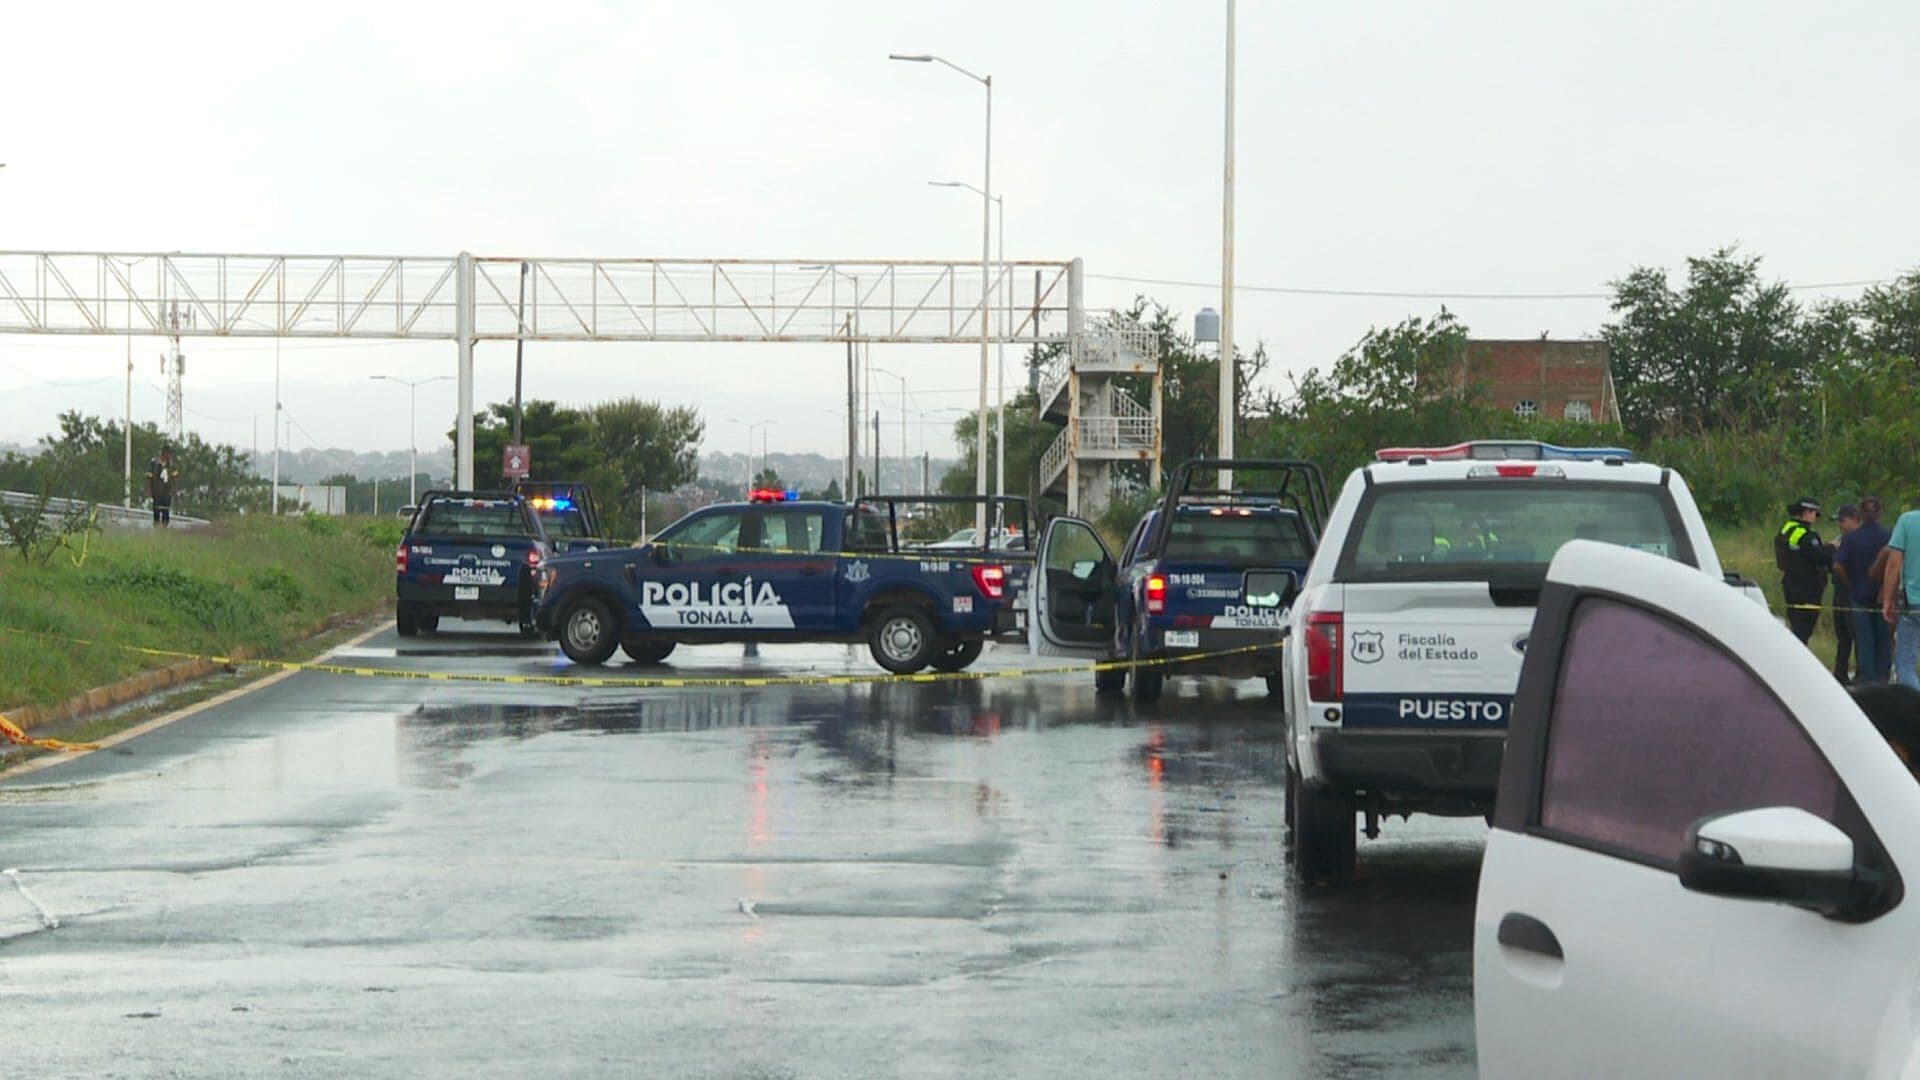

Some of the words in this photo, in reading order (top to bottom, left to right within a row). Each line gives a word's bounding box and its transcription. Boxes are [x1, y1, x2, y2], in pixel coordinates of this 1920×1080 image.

[642, 575, 781, 606] POLICÍA
[677, 608, 753, 625] TONALÁ
[1398, 633, 1455, 646] Fiscalía
[1358, 642, 1377, 653] FE
[1398, 648, 1421, 660] del
[1426, 648, 1478, 660] Estado
[1400, 700, 1503, 720] PUESTO
